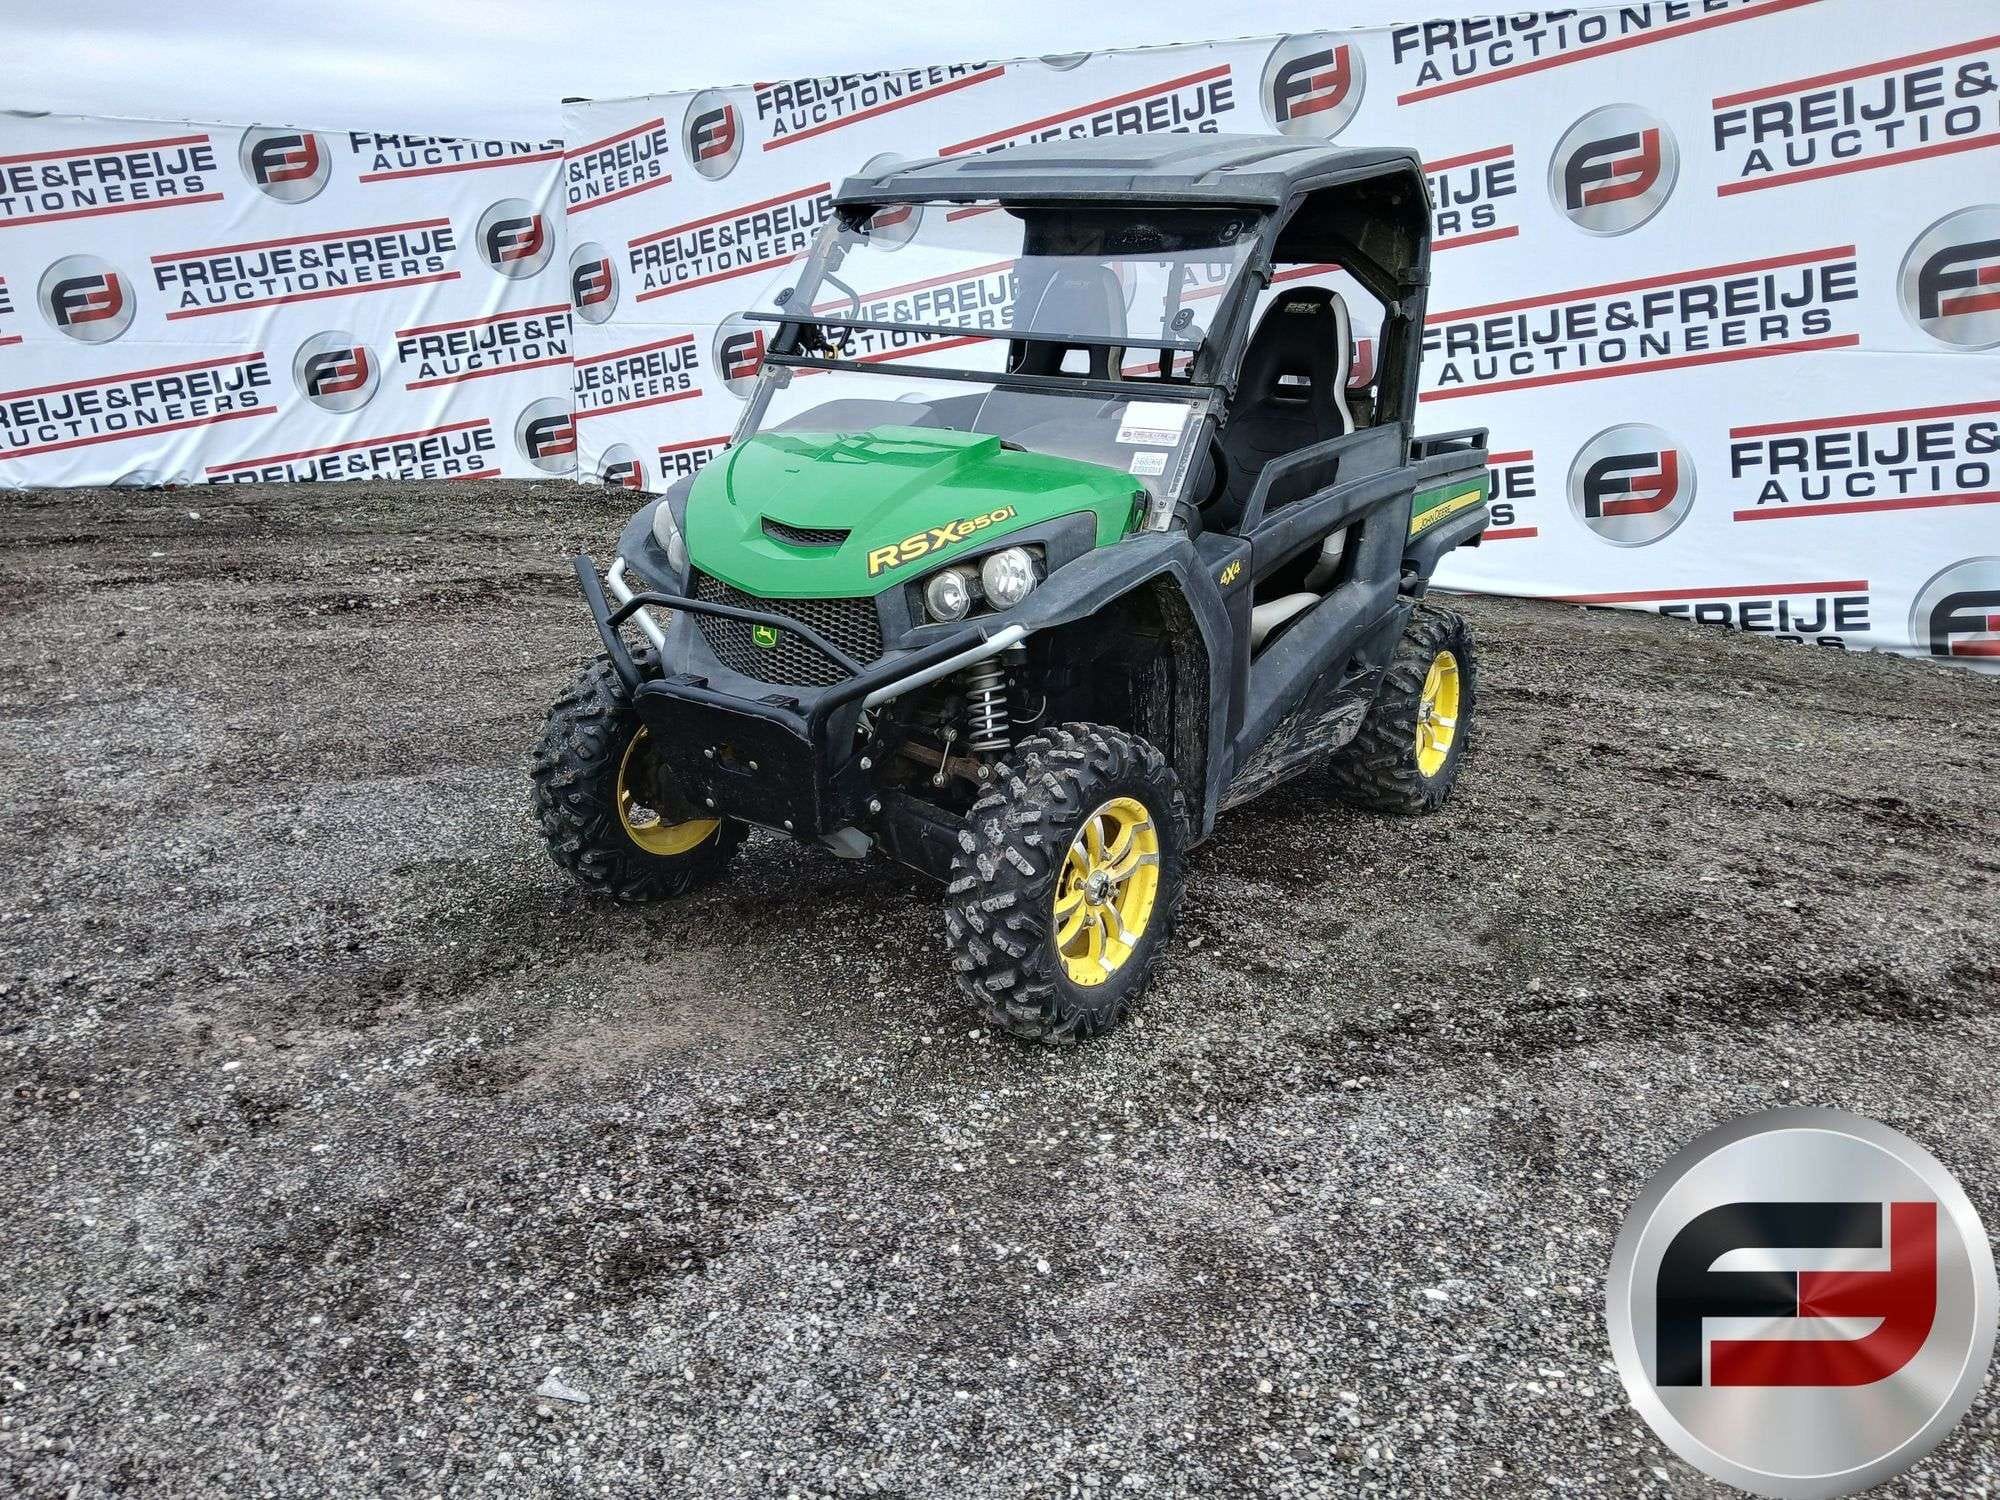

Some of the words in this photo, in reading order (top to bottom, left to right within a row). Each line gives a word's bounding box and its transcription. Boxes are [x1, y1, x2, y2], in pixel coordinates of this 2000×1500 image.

[1741, 102, 2000, 176] AUCTIO
[153, 227, 456, 291] FREIJE&FREIJE
[180, 256, 444, 308] AUCTIONEERS
[419, 339, 566, 379] AUCTION
[1438, 308, 1831, 386] AUCTIONEERS
[578, 373, 691, 408] TIONEERS
[0, 391, 259, 449] UCTIONEERS
[1757, 461, 1990, 504] AUCTIO
